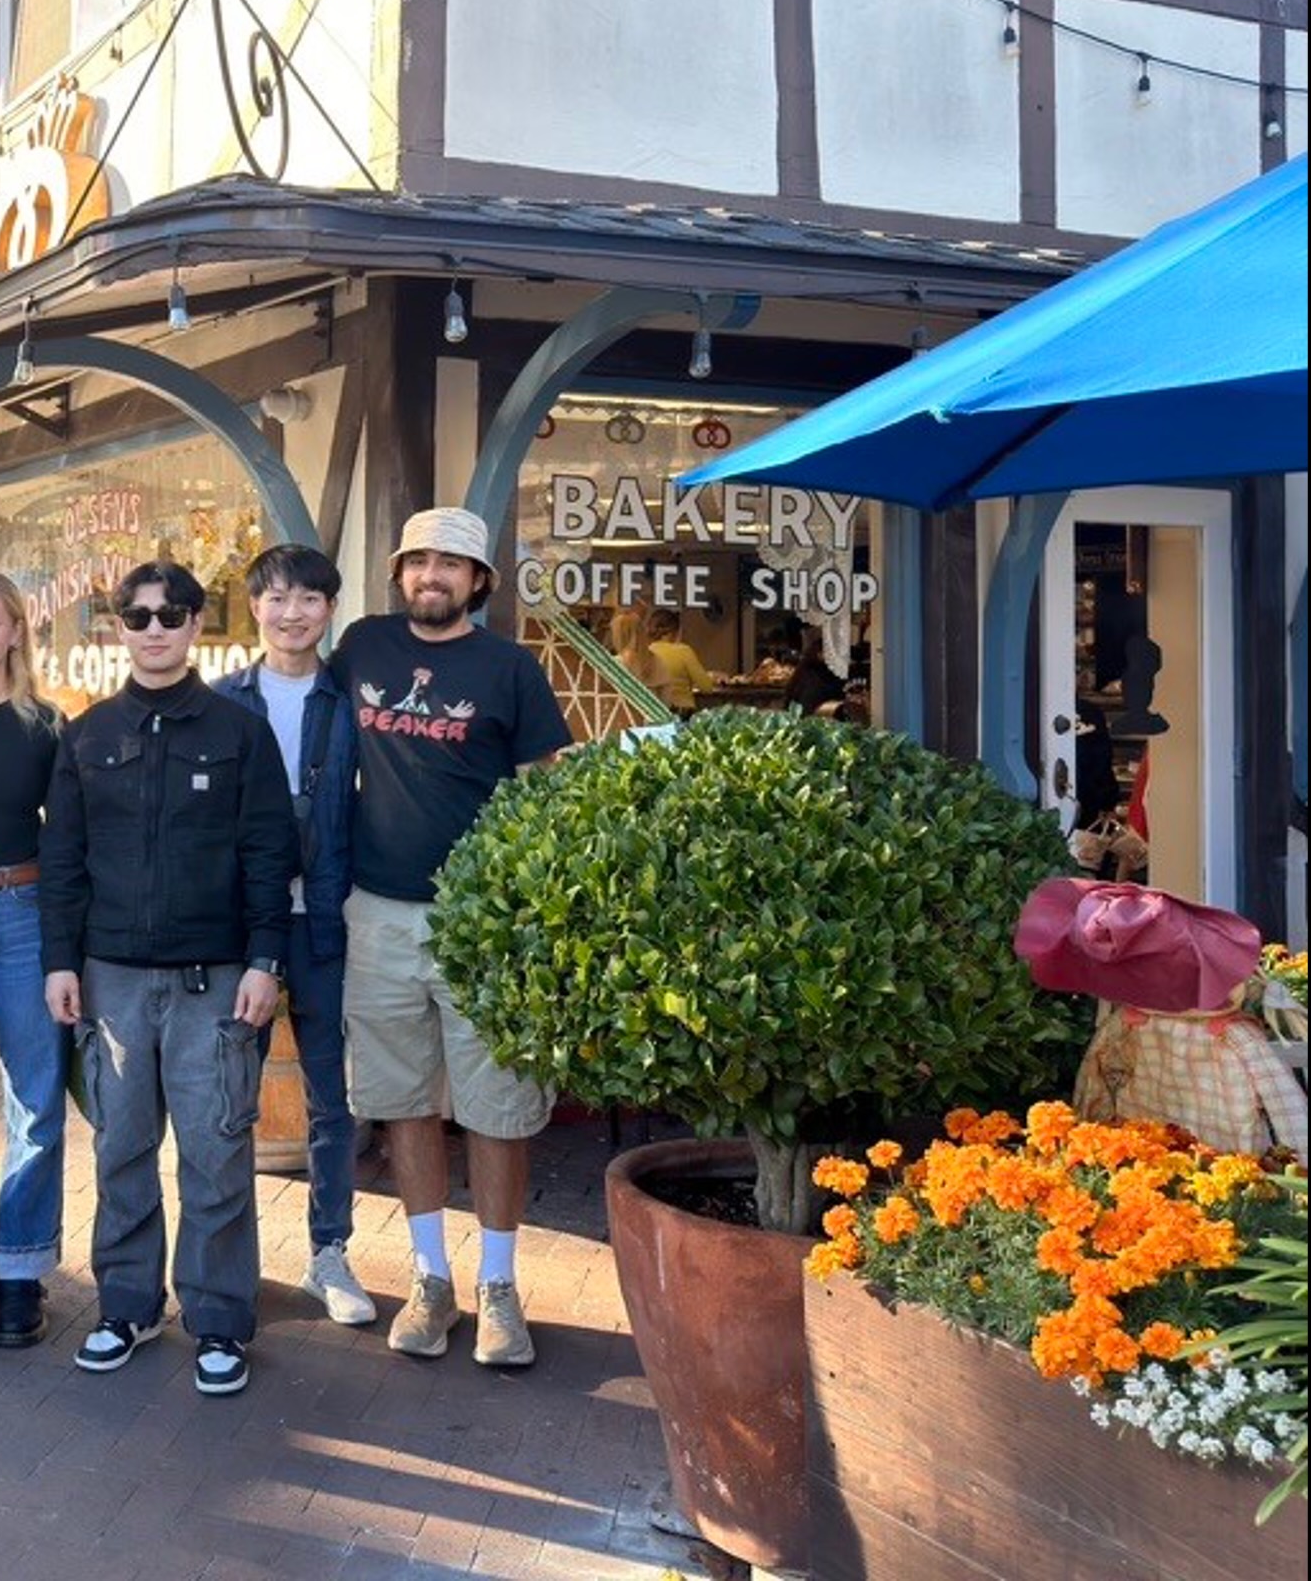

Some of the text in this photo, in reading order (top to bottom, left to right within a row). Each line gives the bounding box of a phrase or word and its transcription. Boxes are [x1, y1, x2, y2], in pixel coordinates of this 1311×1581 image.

[551, 473, 860, 551] BAKERY
[516, 559, 879, 615] COFFEE SHOP
[68, 644, 131, 697] COFF
[359, 706, 468, 743] BEAKER
